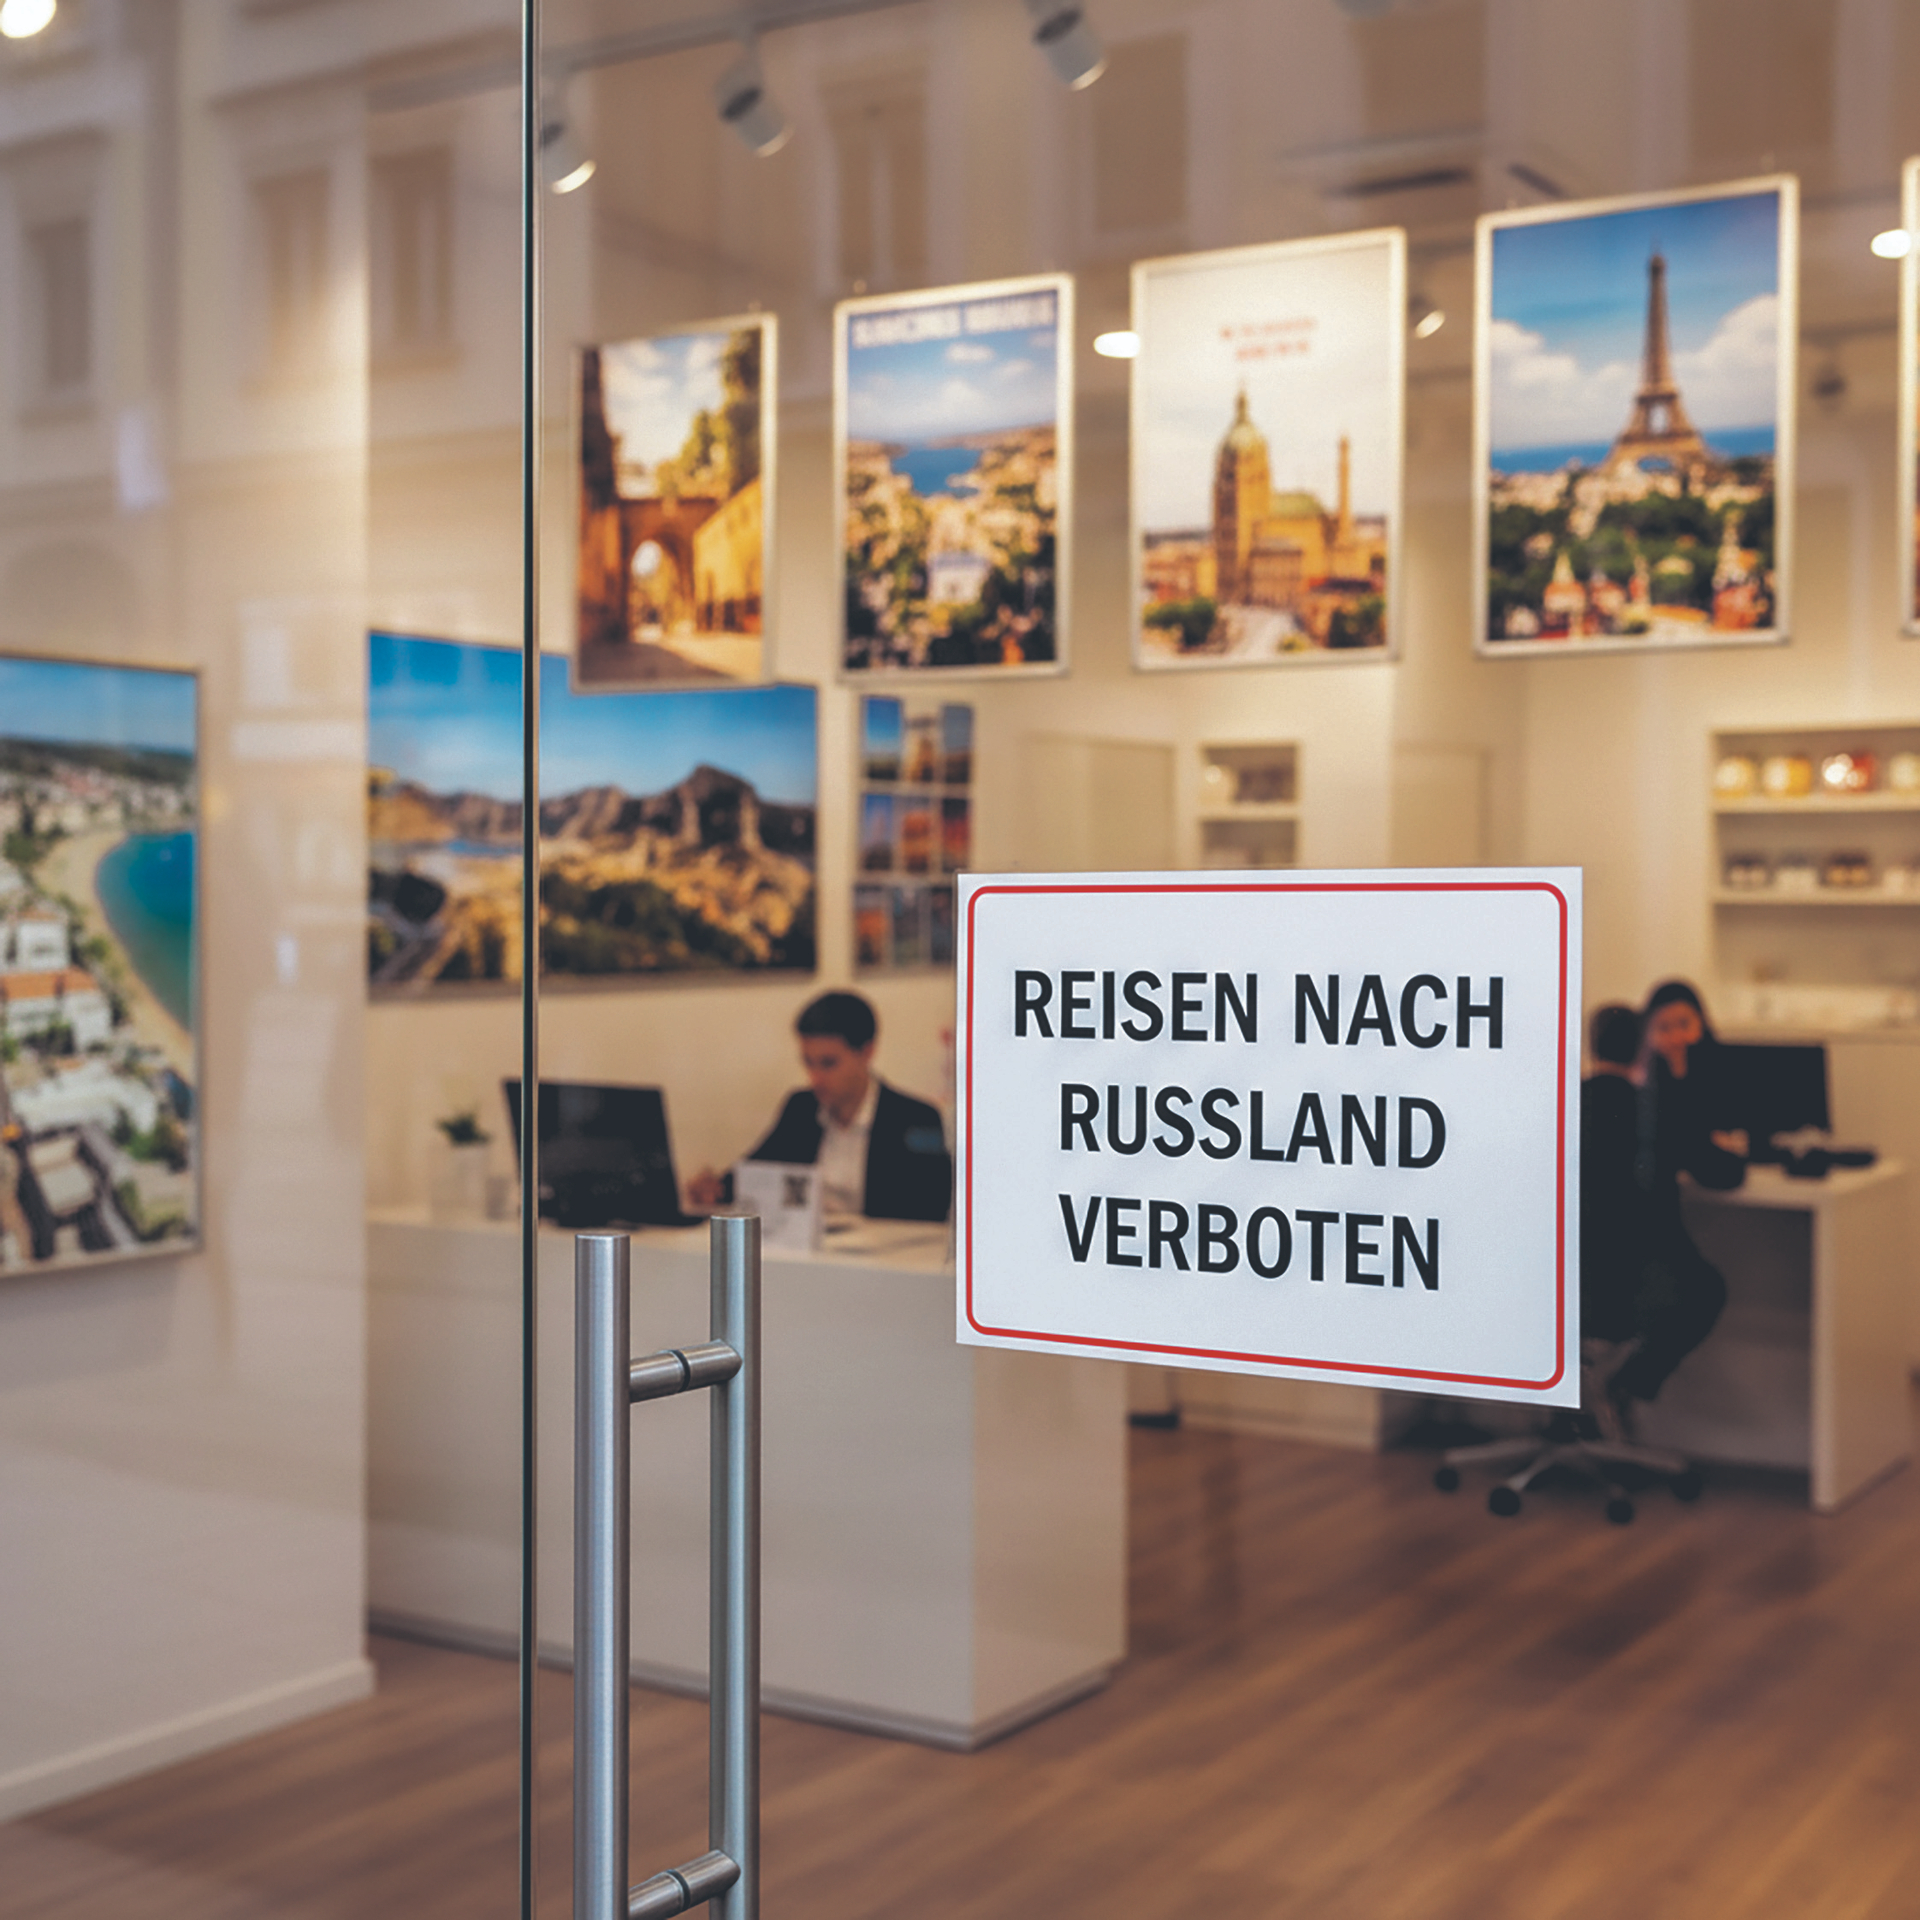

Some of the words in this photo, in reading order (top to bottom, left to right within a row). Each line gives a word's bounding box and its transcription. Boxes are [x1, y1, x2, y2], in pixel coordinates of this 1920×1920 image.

[1014, 970, 1258, 1043] REISEN
[1294, 974, 1504, 1049] NACH
[1060, 1083, 1446, 1169] RUSSLAND
[1058, 1193, 1439, 1291] VERBOTEN
